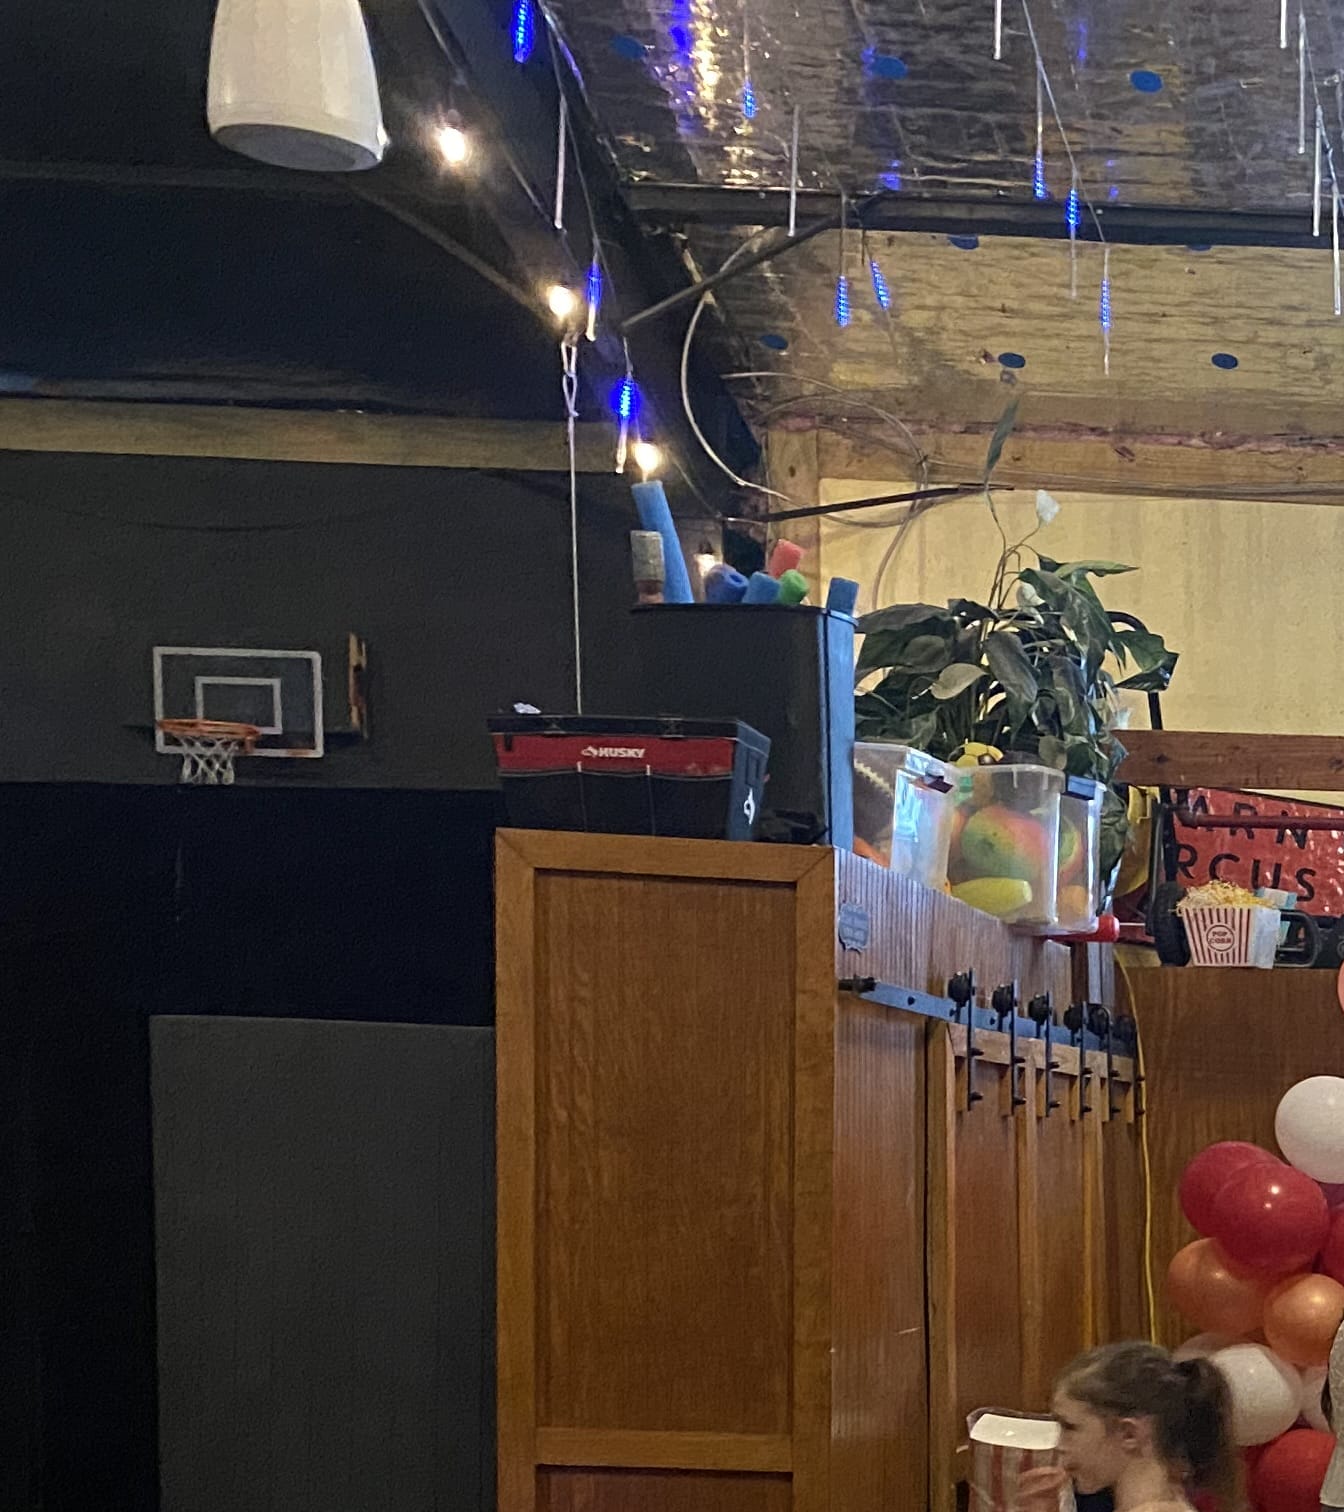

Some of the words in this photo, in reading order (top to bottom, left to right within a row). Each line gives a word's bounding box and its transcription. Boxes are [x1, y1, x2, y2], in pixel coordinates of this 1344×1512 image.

[599, 747, 645, 758] HUSKY
[1193, 795, 1308, 850] ARN
[1177, 844, 1316, 902] RCUS
